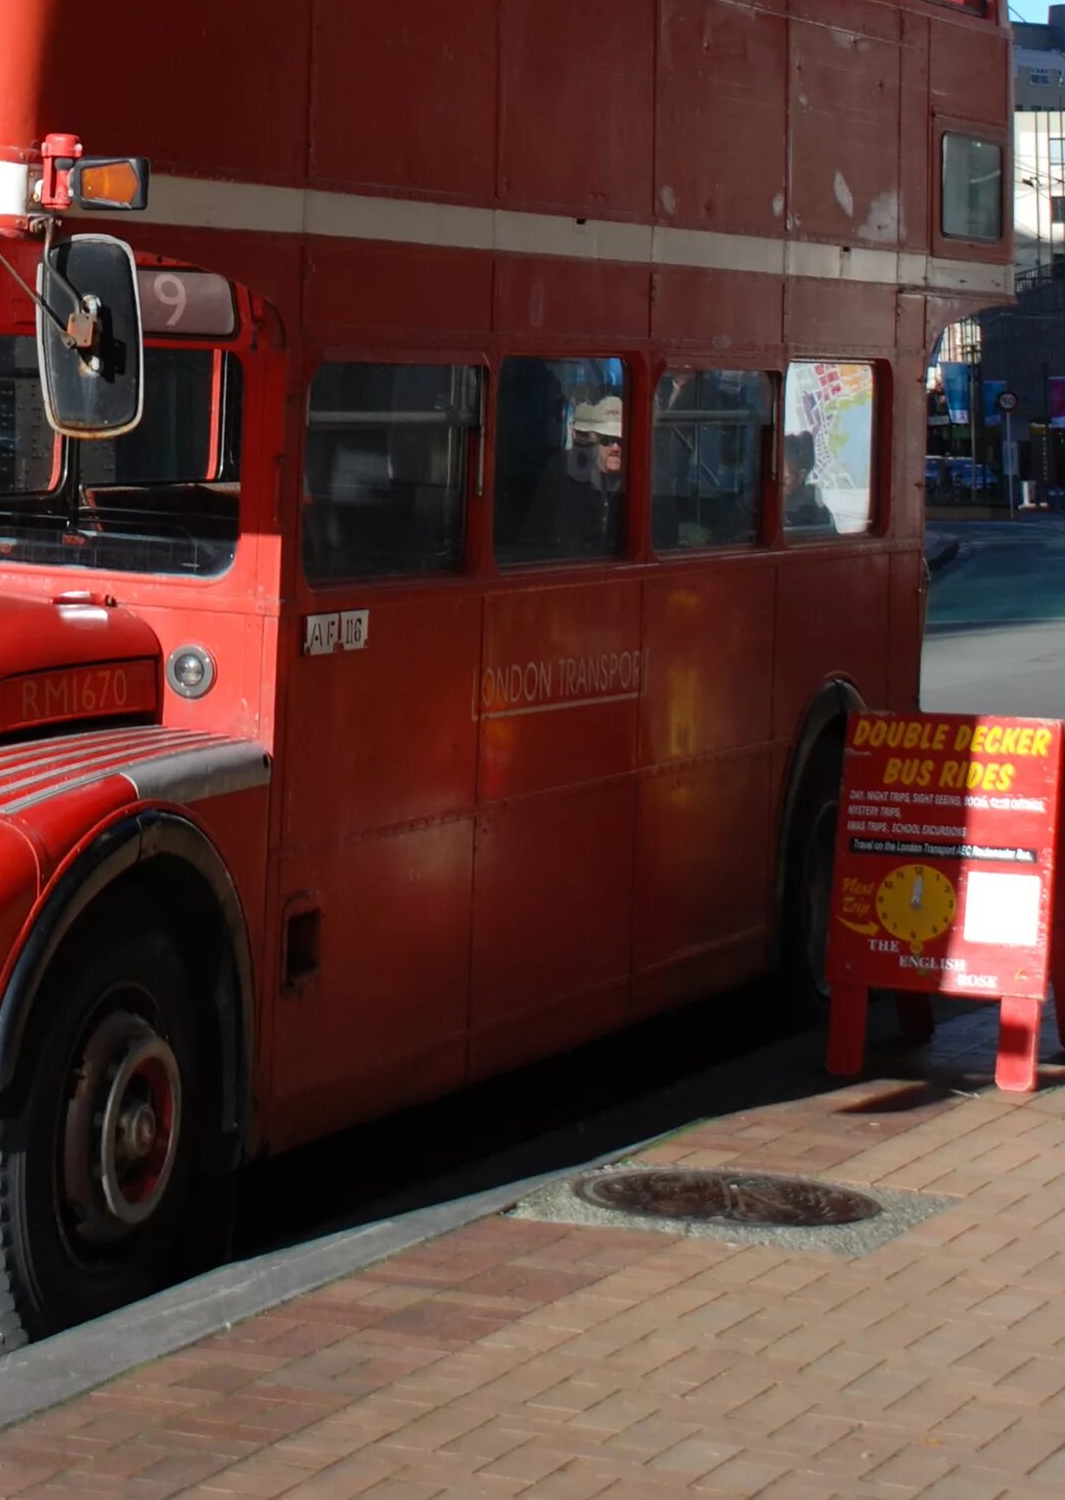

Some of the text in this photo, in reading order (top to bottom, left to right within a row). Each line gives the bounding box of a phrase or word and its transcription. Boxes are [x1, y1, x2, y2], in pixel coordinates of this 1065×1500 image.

[154, 274, 186, 326] 9
[346, 618, 362, 645] 116
[472, 646, 652, 722] LONDON TRANSPORT
[22, 669, 127, 721] RM1670
[853, 719, 1052, 757] DOUBLE DECKER
[883, 758, 1015, 791] BUS RIDES
[891, 823, 920, 835] SCHOOL
[854, 838, 874, 850] Travel
[874, 841, 884, 850] on
[884, 841, 896, 852] the
[896, 841, 923, 852] London
[923, 842, 956, 856] Transport
[842, 876, 874, 895] Next
[842, 897, 870, 918] Trip
[868, 938, 900, 953] THE
[899, 955, 966, 972] ENGLISH
[956, 973, 998, 989] ROSE
